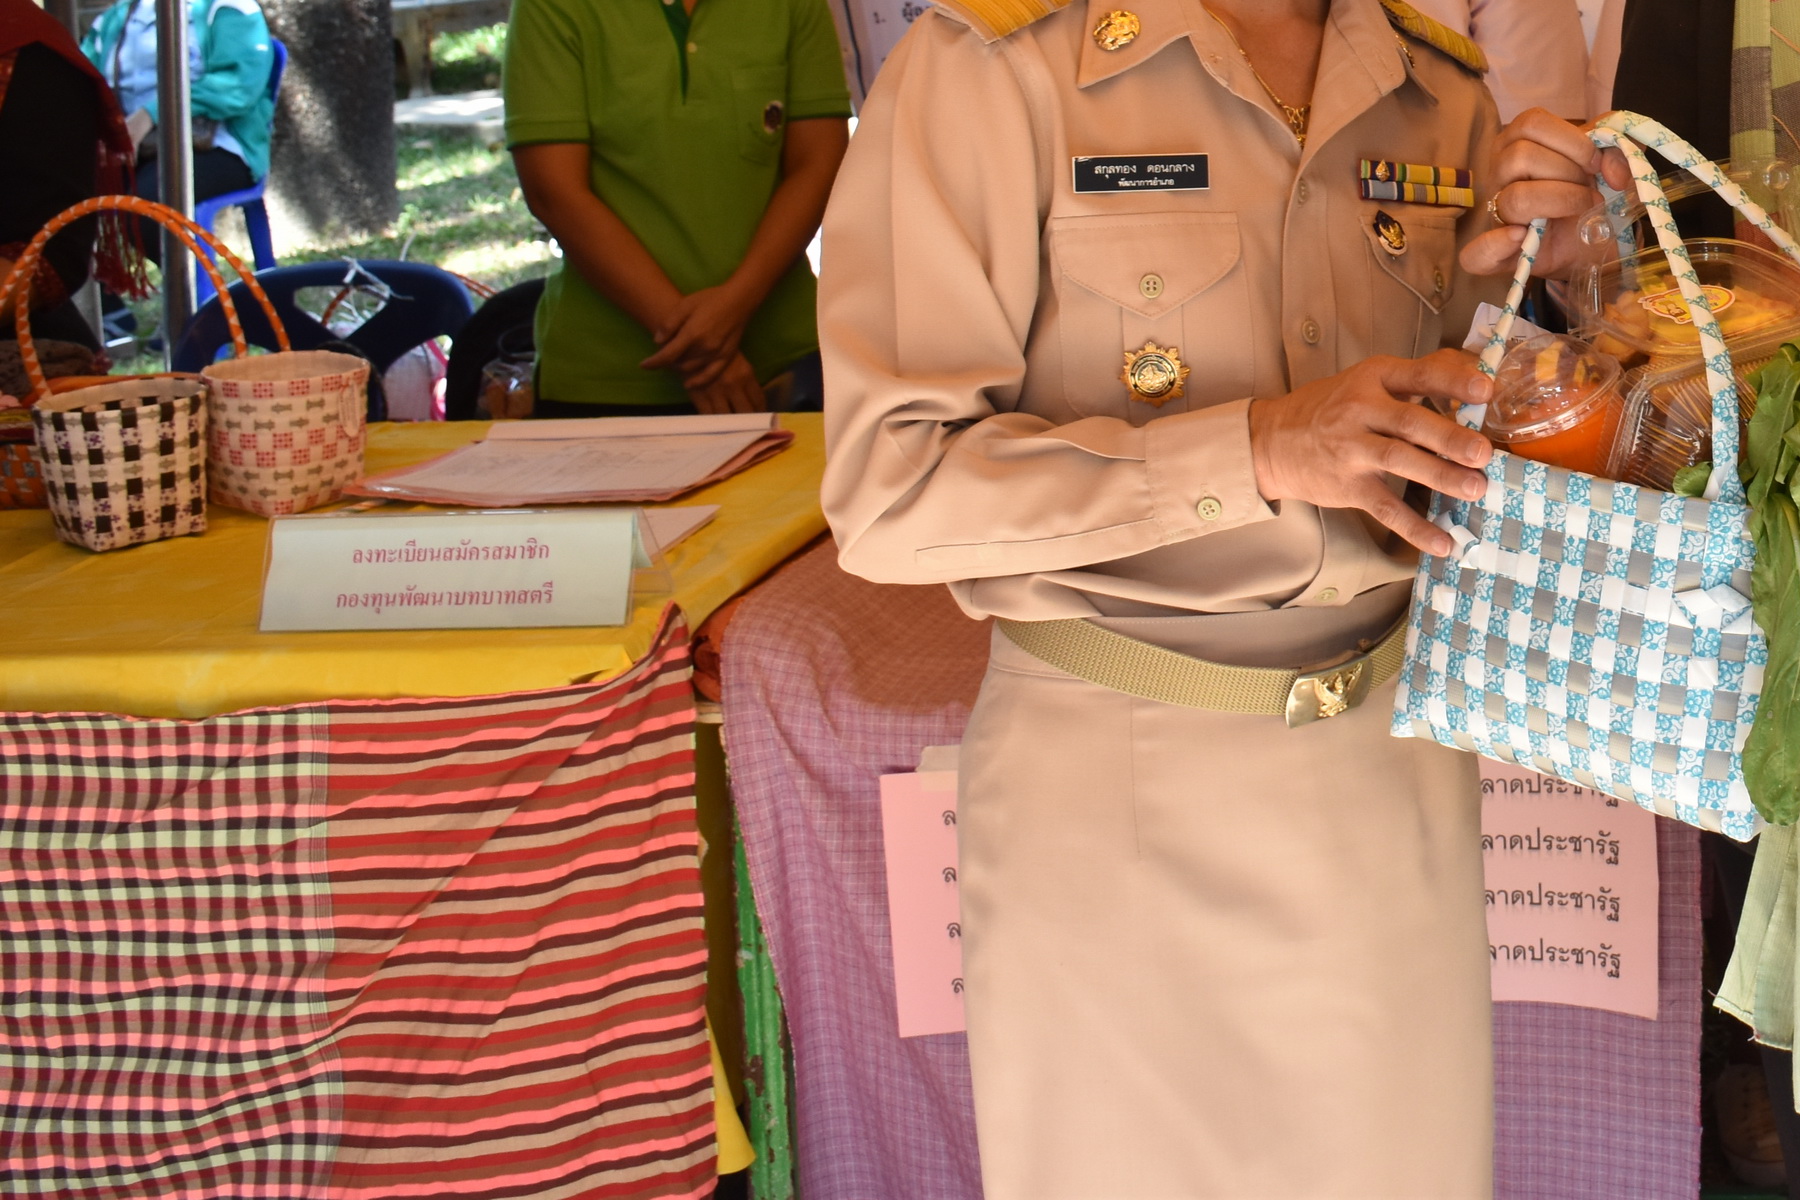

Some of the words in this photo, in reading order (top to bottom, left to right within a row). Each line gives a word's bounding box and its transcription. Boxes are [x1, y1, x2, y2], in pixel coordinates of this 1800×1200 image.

[1094, 164, 1137, 179] สกุลทอง
[352, 537, 550, 564] ลงทะเบียนสมัครสมาชิก
[335, 580, 554, 614] กองทุนพัฒนาบทบาทสตรี
